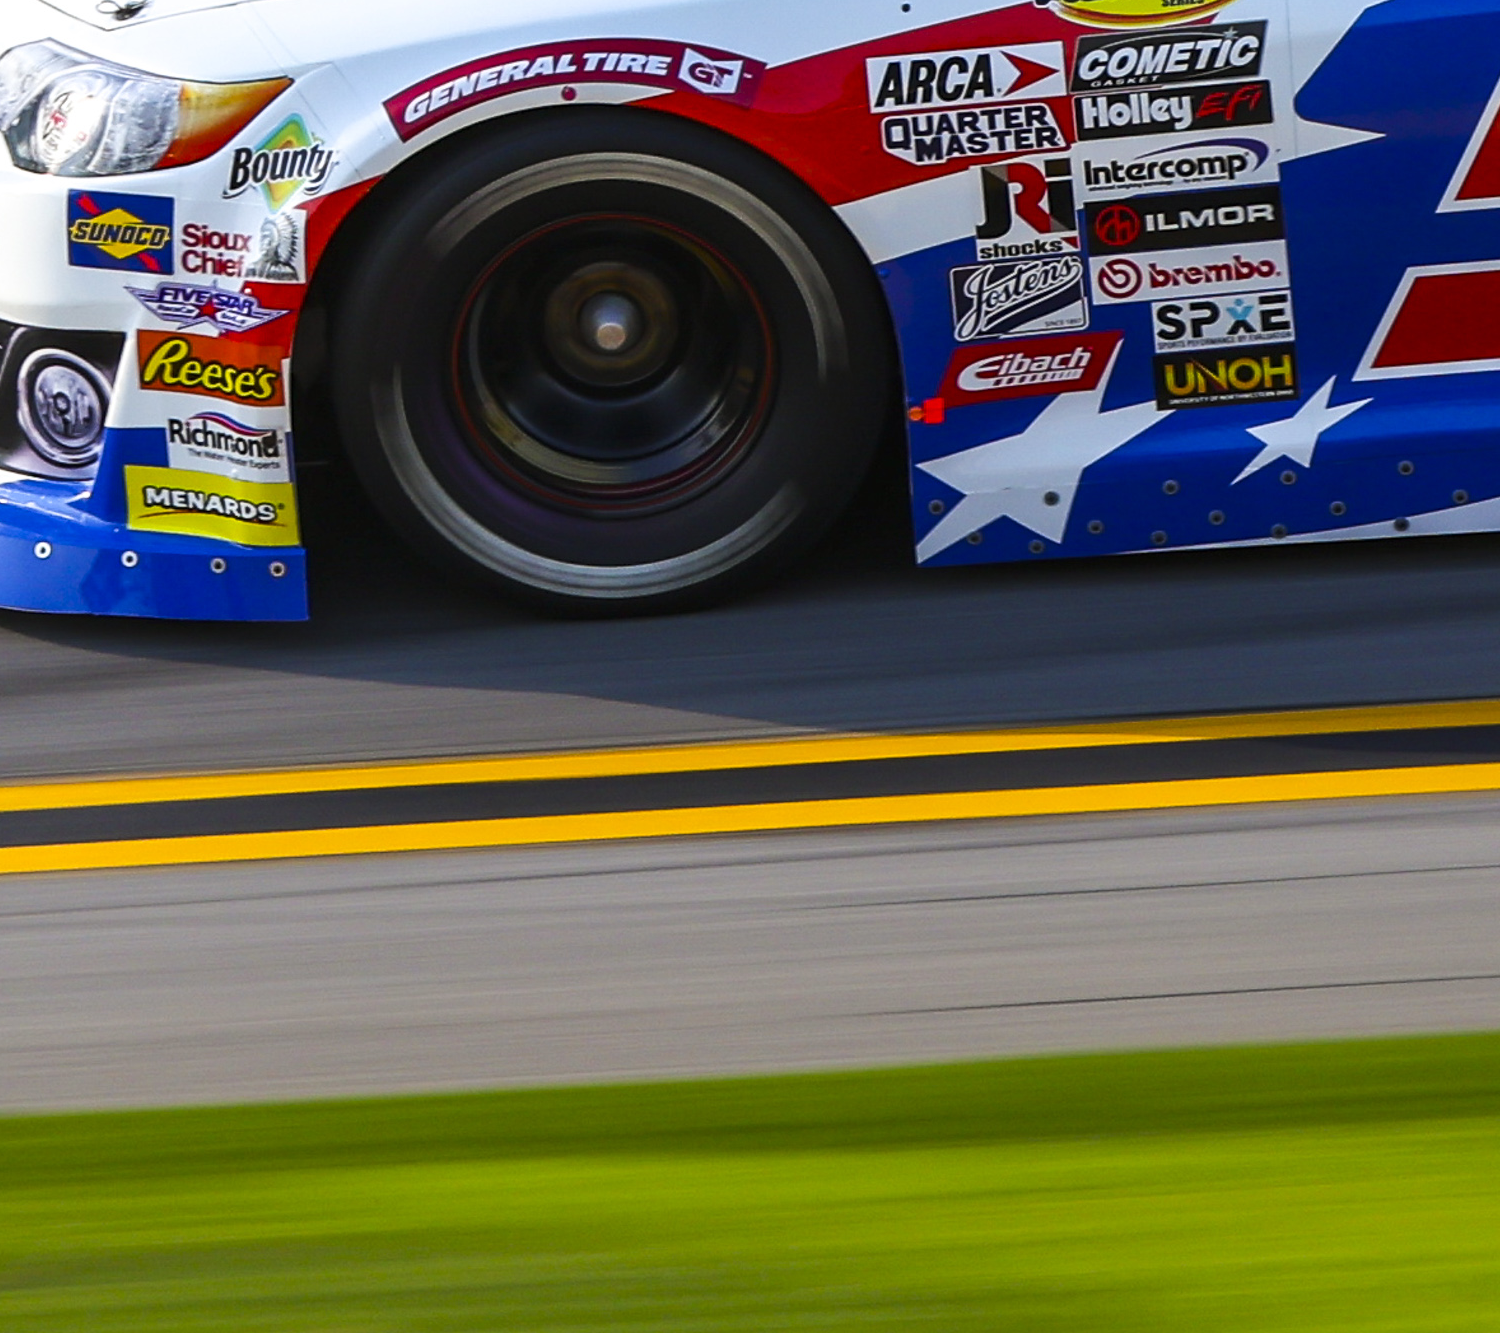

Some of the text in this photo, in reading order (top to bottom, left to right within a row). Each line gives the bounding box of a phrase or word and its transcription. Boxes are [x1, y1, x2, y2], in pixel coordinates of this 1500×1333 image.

[1079, 35, 1259, 81] COMETIC
[404, 53, 579, 124] GENERAL
[581, 52, 673, 76] TIRE
[873, 53, 994, 108] ARCA
[1091, 75, 1160, 88] GASKET
[884, 105, 1049, 151] QUARTER
[1081, 93, 1193, 130] Holley
[915, 126, 1061, 162] MASTER
[229, 144, 333, 193] Bounty
[1083, 153, 1248, 185] Intercomp
[72, 221, 169, 247] SUNOCO
[1143, 203, 1276, 232] ILMOR
[182, 223, 252, 252] Sioux
[979, 239, 1063, 259] shocks
[182, 250, 245, 277] Chief
[1149, 255, 1277, 288] brembo
[159, 287, 254, 316] FIVE STAR
[954, 256, 1084, 342] Jostens
[143, 338, 277, 399] Reese's
[957, 346, 1093, 392] Eibach
[1164, 354, 1294, 396] UNOH
[168, 418, 279, 458] Richmond
[144, 486, 277, 522] MENARDS
